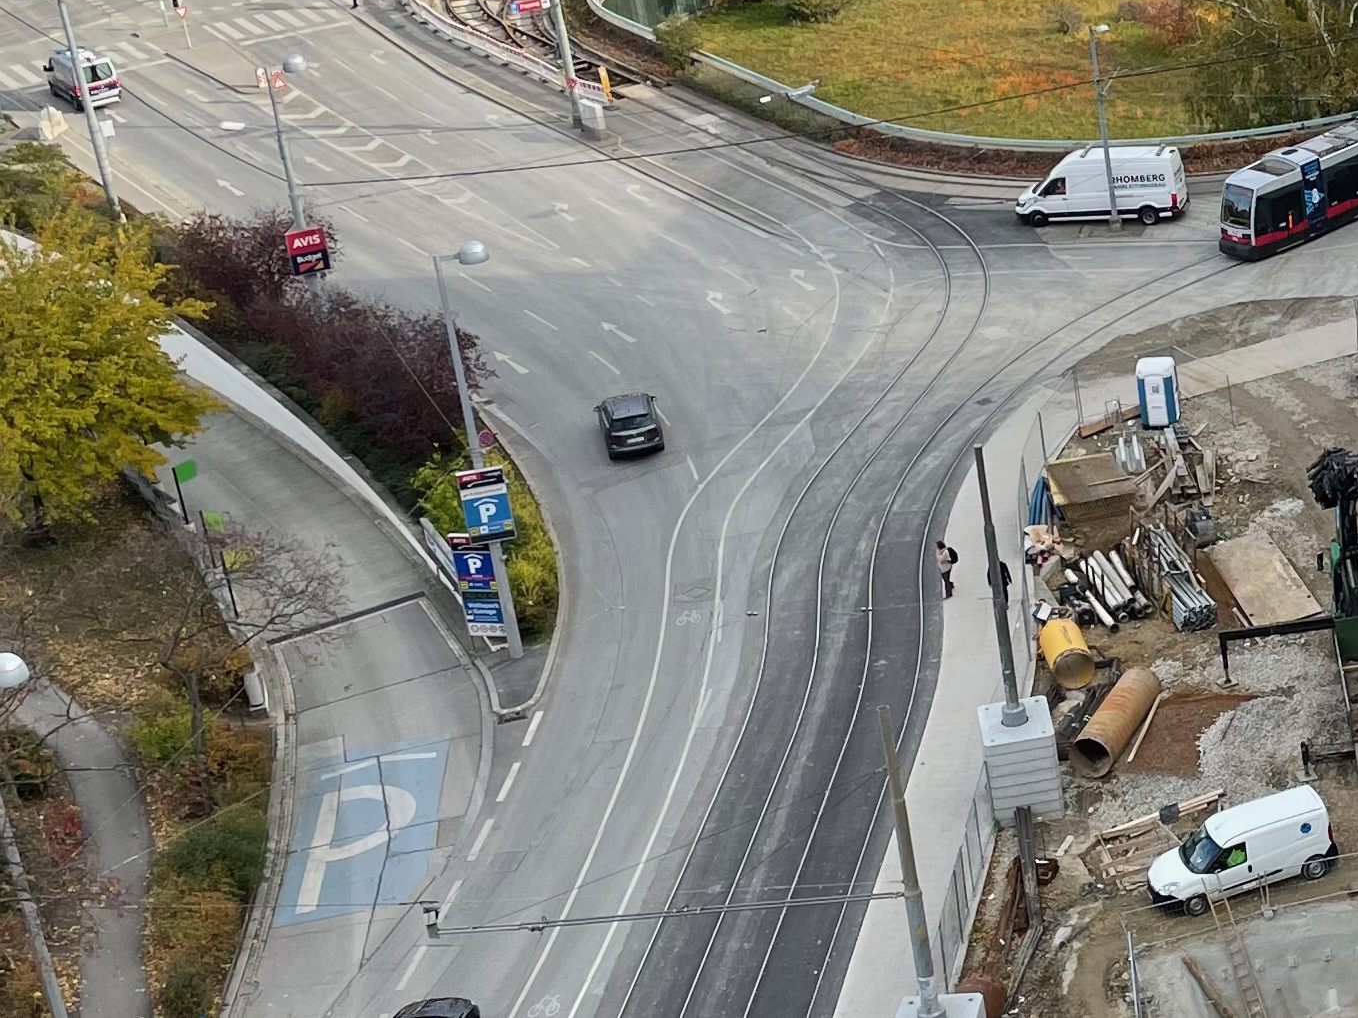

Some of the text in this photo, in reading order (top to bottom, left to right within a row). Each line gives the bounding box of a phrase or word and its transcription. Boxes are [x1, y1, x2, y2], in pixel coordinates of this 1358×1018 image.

[293, 234, 321, 249] AVIS
[296, 252, 322, 264] Budget
[478, 503, 497, 524] P
[467, 558, 482, 574] P
[295, 785, 417, 914] P
